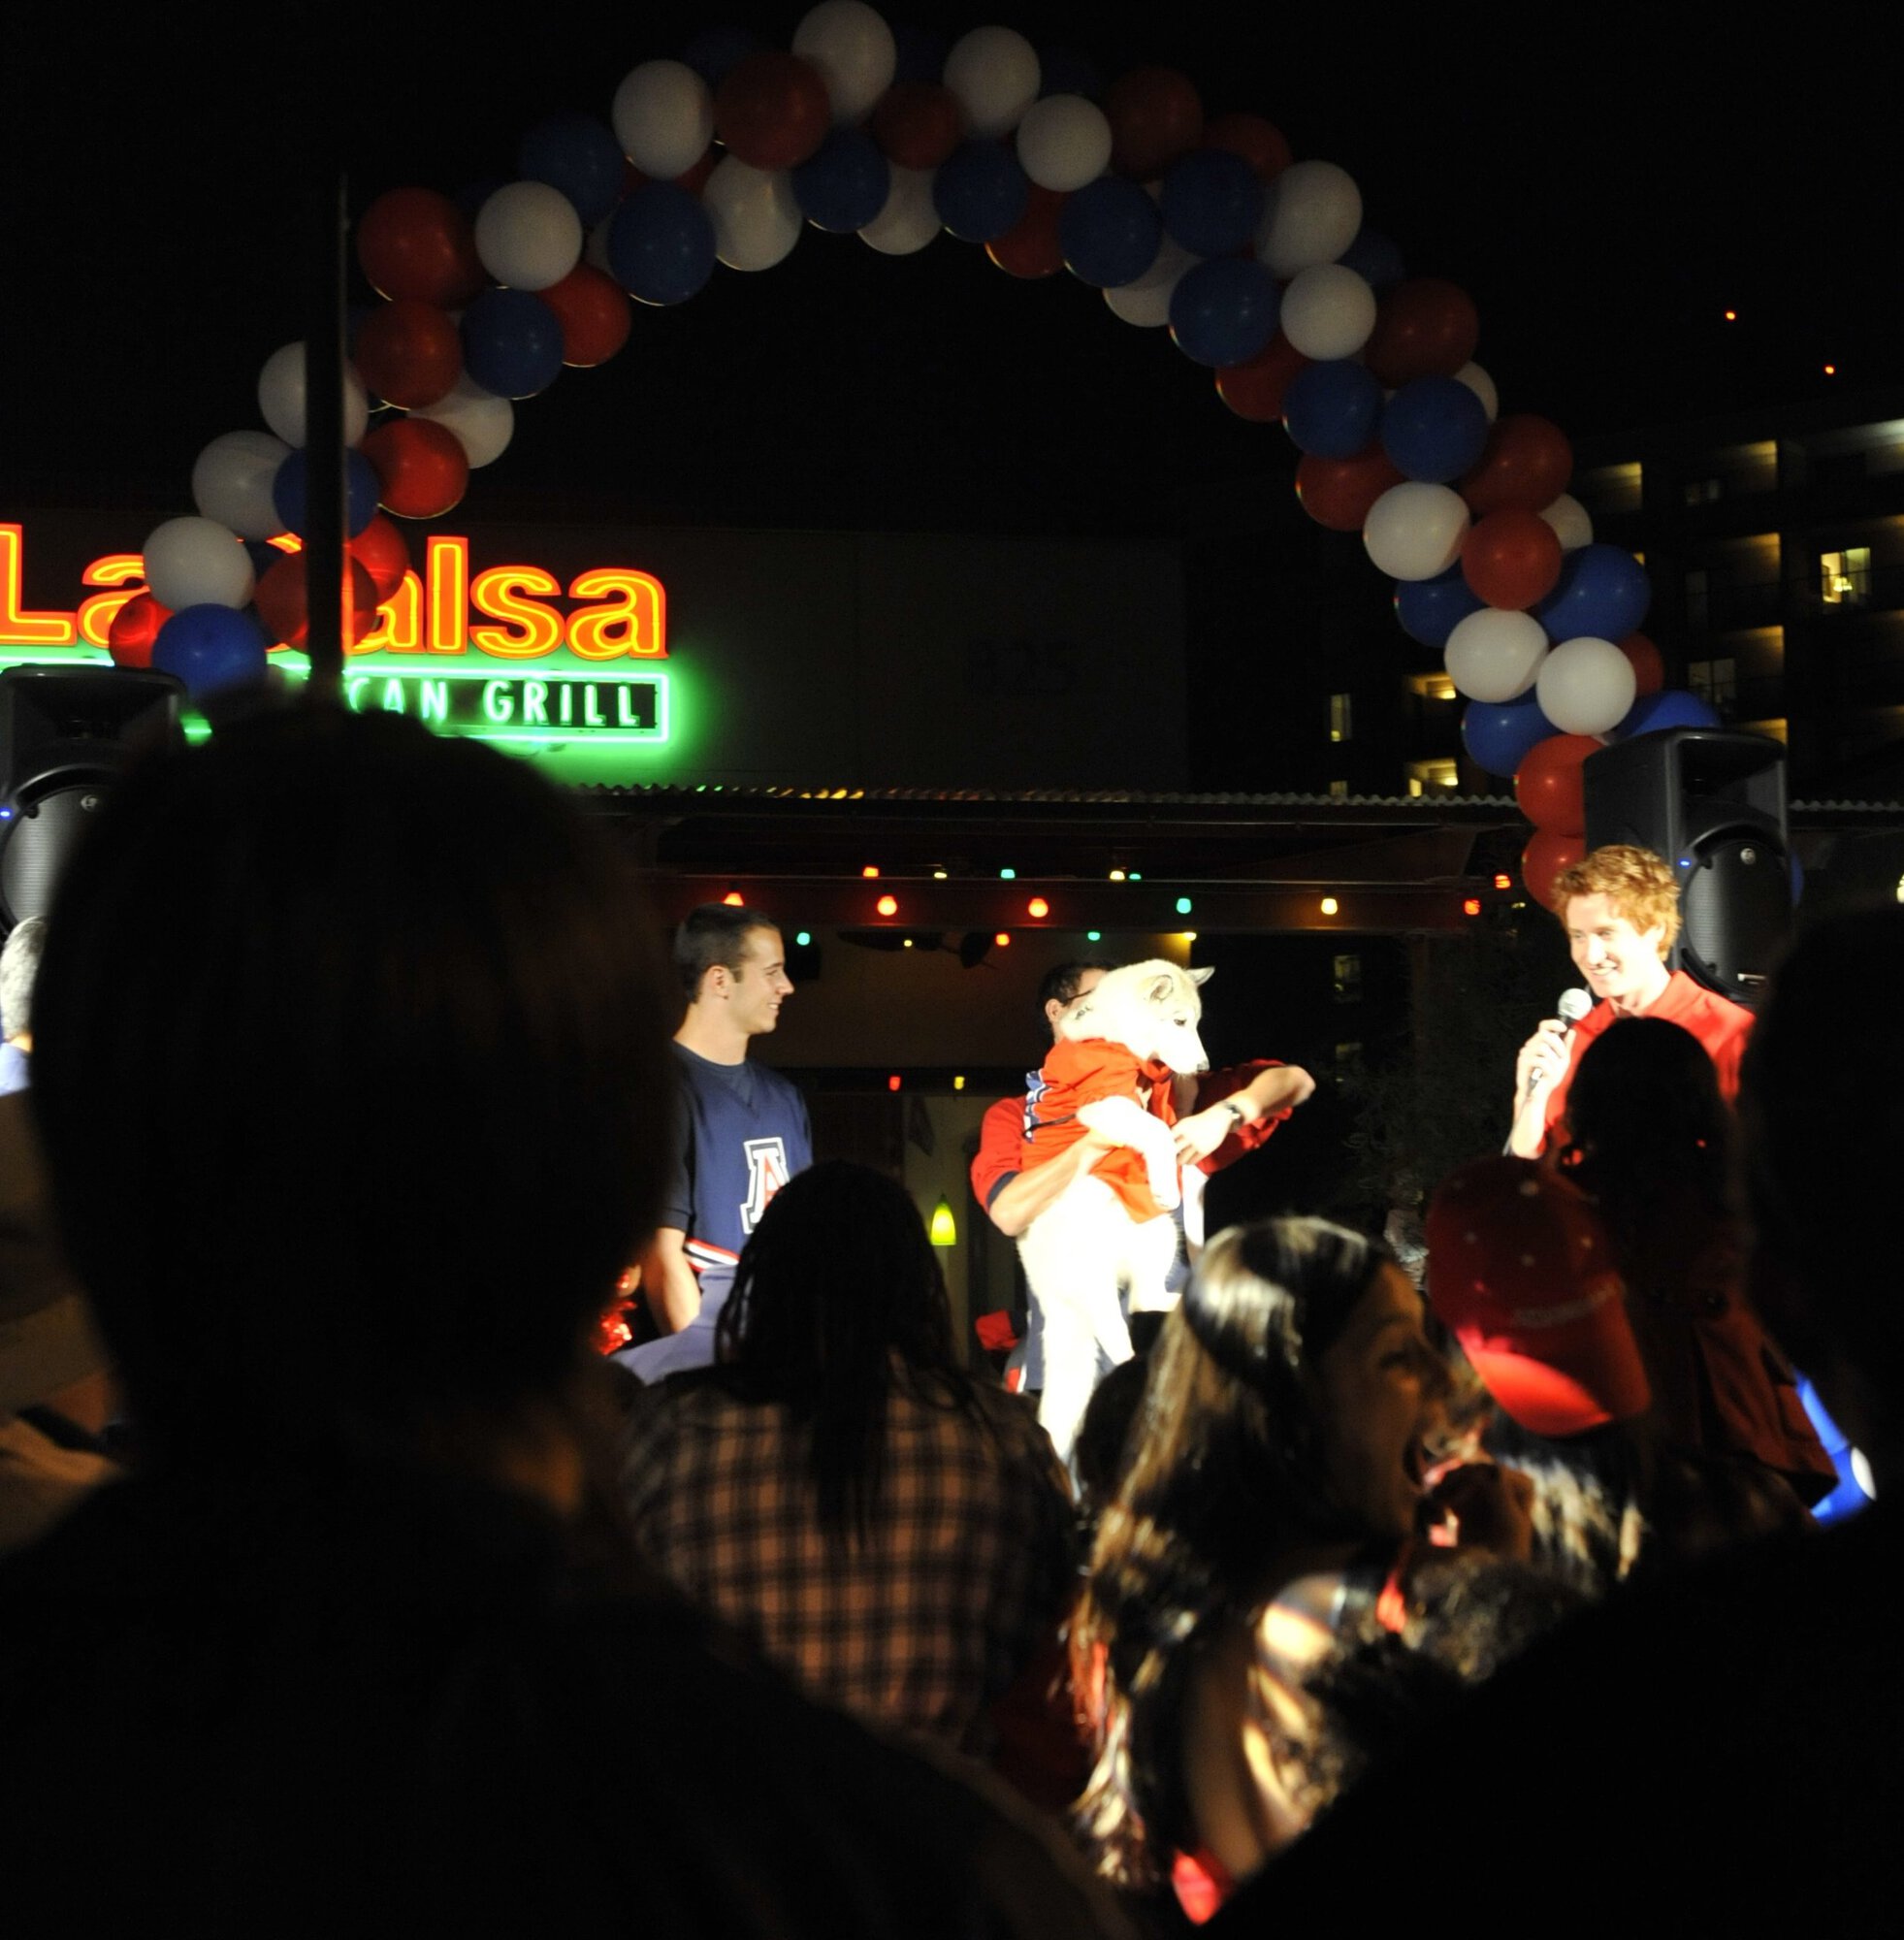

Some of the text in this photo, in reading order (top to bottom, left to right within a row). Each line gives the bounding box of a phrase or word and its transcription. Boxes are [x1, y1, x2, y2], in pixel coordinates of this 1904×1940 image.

[266, 534, 668, 661] alsa
[483, 679, 640, 727] GRILL
[740, 1137, 791, 1234] A
